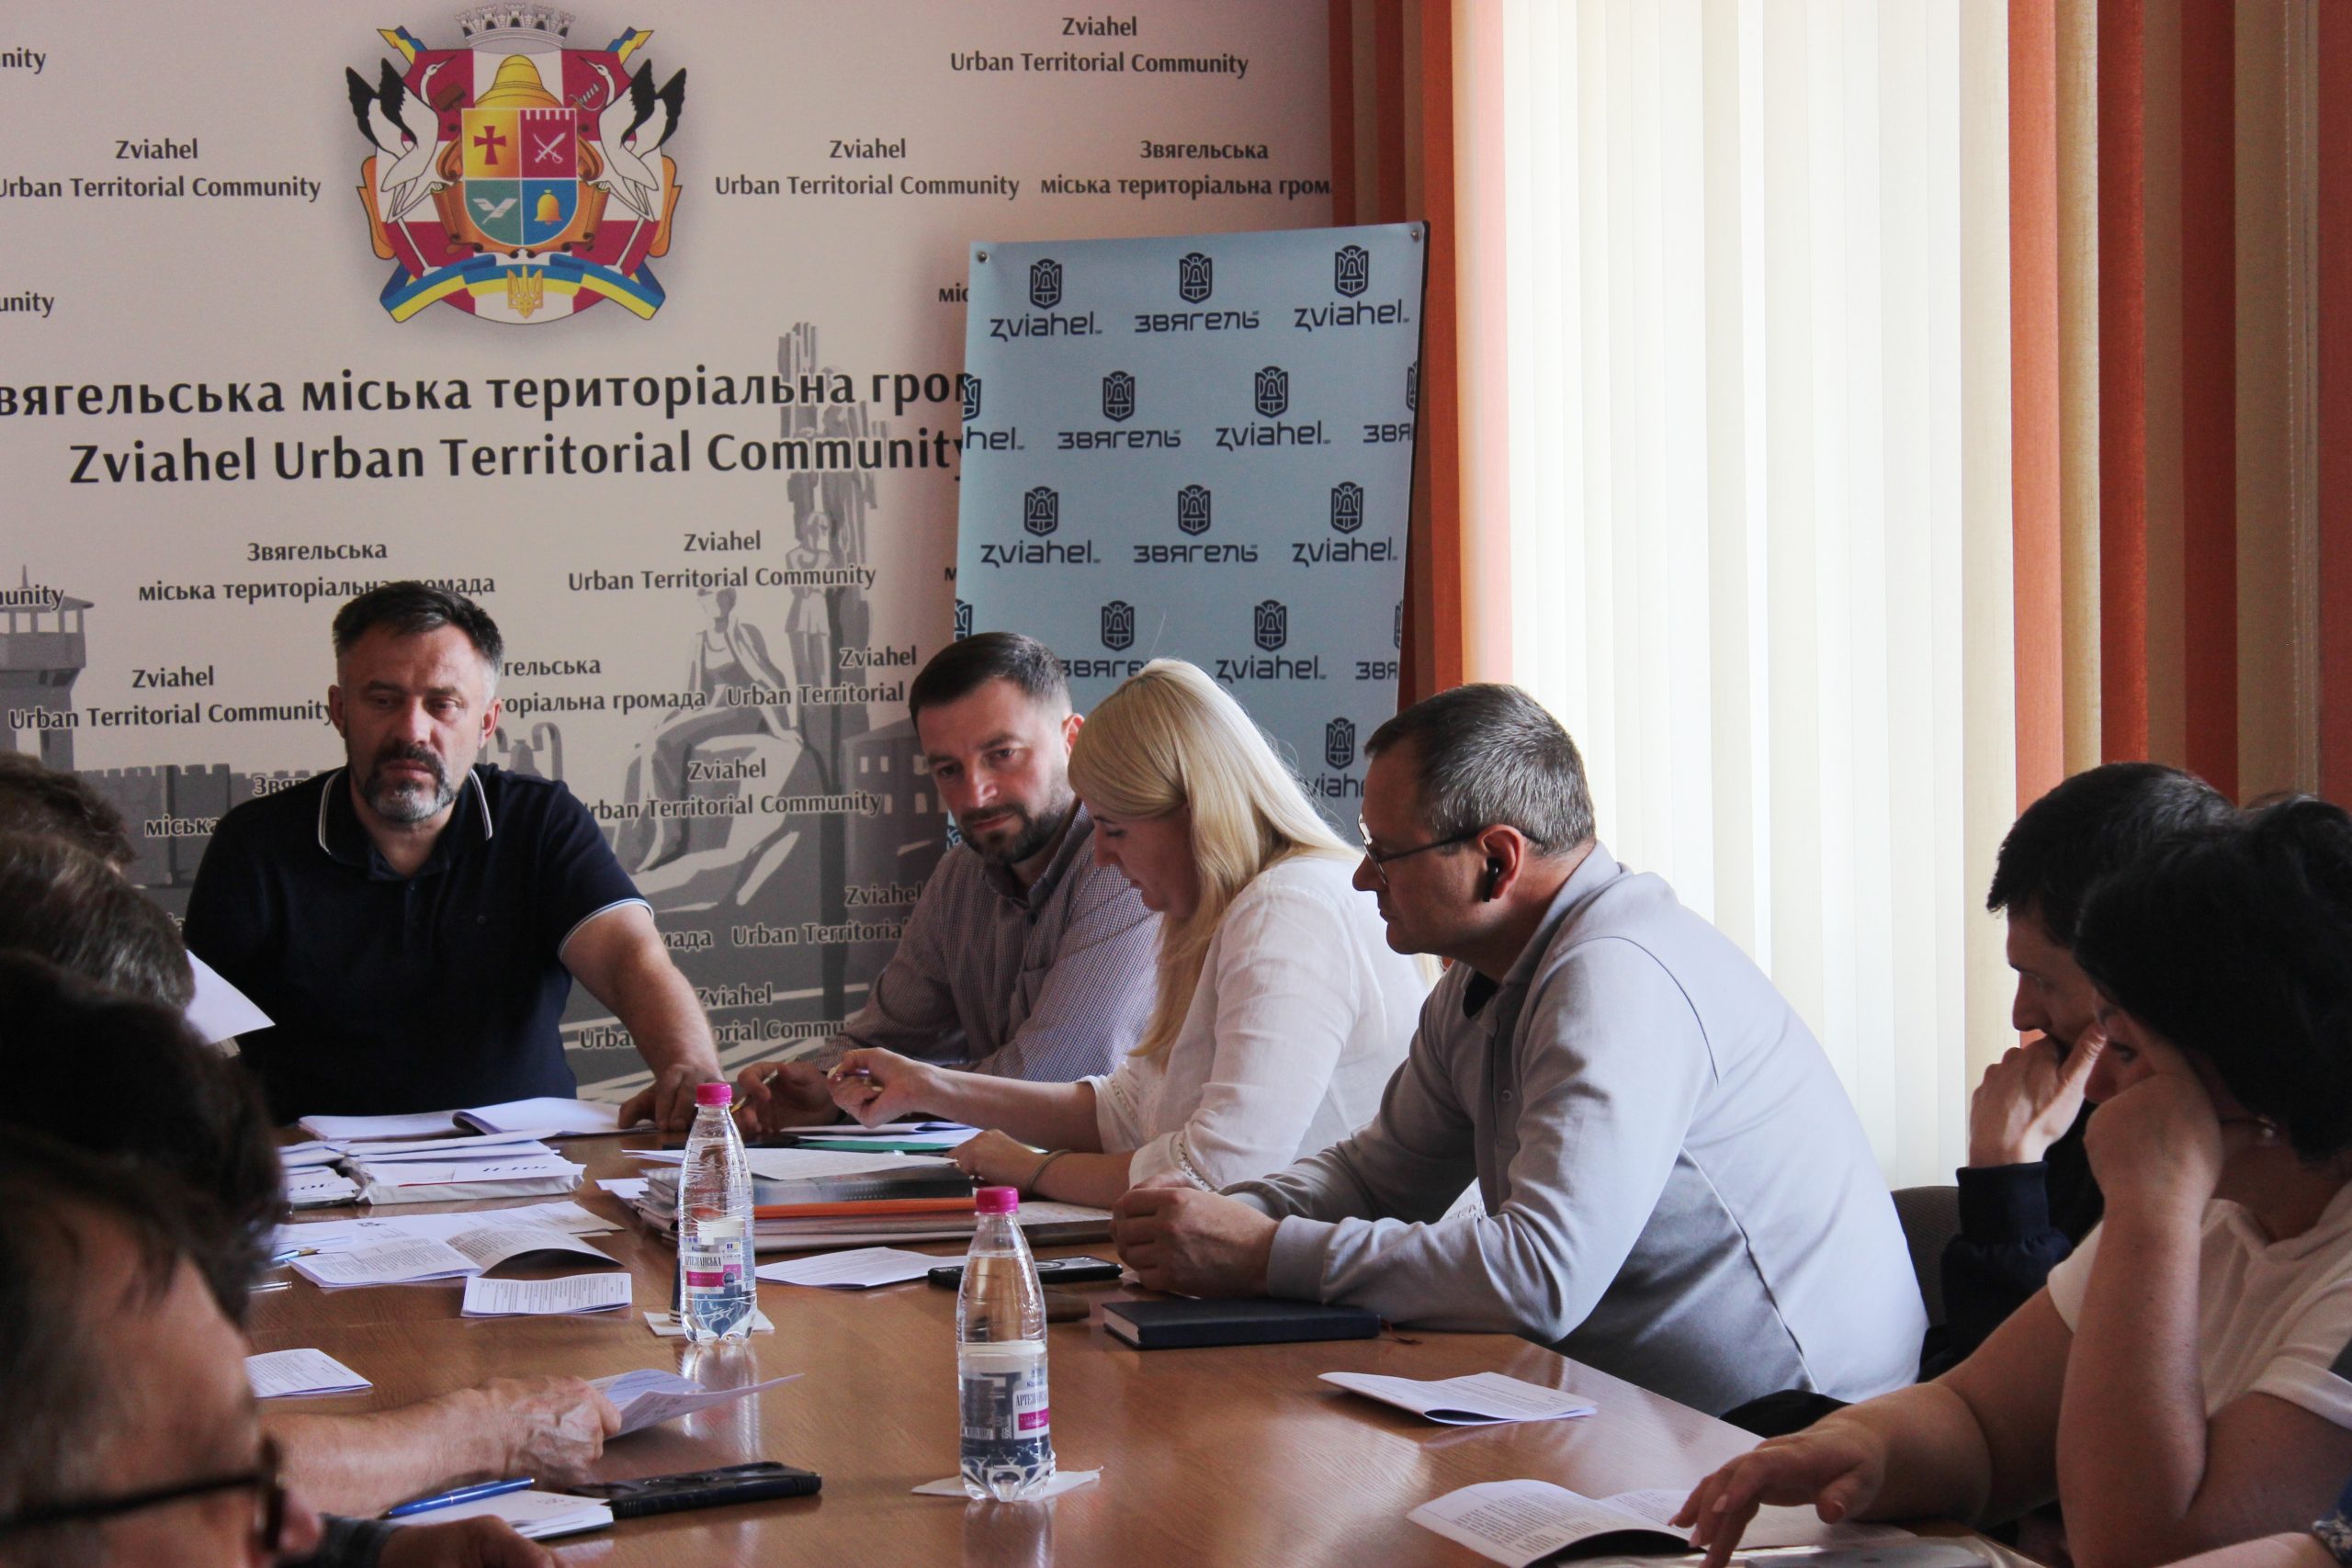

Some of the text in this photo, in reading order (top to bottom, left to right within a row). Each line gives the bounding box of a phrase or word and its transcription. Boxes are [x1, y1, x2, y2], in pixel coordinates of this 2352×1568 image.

[1062, 15, 1137, 37] Zviahel
[950, 50, 1250, 80] Urban Territorial Community
[115, 137, 198, 160] Zviahel
[829, 137, 906, 159] Zviahel
[1140, 140, 1271, 161] Звягельська
[69, 175, 185, 197] Territorial
[192, 175, 322, 203] Community
[715, 174, 1020, 201] Urban Territorial Community
[1041, 174, 1330, 201] міська територіальна гром
[0, 290, 55, 319] unity
[1294, 299, 1403, 333] zviahel
[989, 310, 1094, 343] zviahel
[0, 381, 286, 416] вягельська
[302, 368, 472, 412] міська
[486, 364, 855, 421] територіальна
[1216, 421, 1321, 452] zviahel
[70, 436, 255, 484] Zviahel
[275, 434, 424, 480] Urban
[439, 429, 690, 477] Territorial
[246, 542, 388, 562] Звягельська
[684, 530, 762, 552] Zviahel
[1292, 536, 1392, 569] zviahel
[980, 540, 1091, 569] zviahel
[139, 580, 216, 601] міська
[569, 565, 876, 591] Urban Territorial Community
[0, 585, 63, 611] unity
[504, 660, 601, 676] гельська
[840, 646, 916, 667] Zviahel
[1216, 654, 1318, 684] zviahel
[131, 664, 214, 689] Zviahel
[612, 691, 706, 716] громада
[727, 682, 903, 705] Urban Territorial
[10, 700, 333, 728] Urban Territorial Community
[688, 759, 765, 781] Zviahel
[584, 791, 881, 819] rban Territorial Community
[846, 884, 921, 905] Zviahel
[733, 923, 796, 944] Urban
[697, 984, 771, 1007] Zviahel
